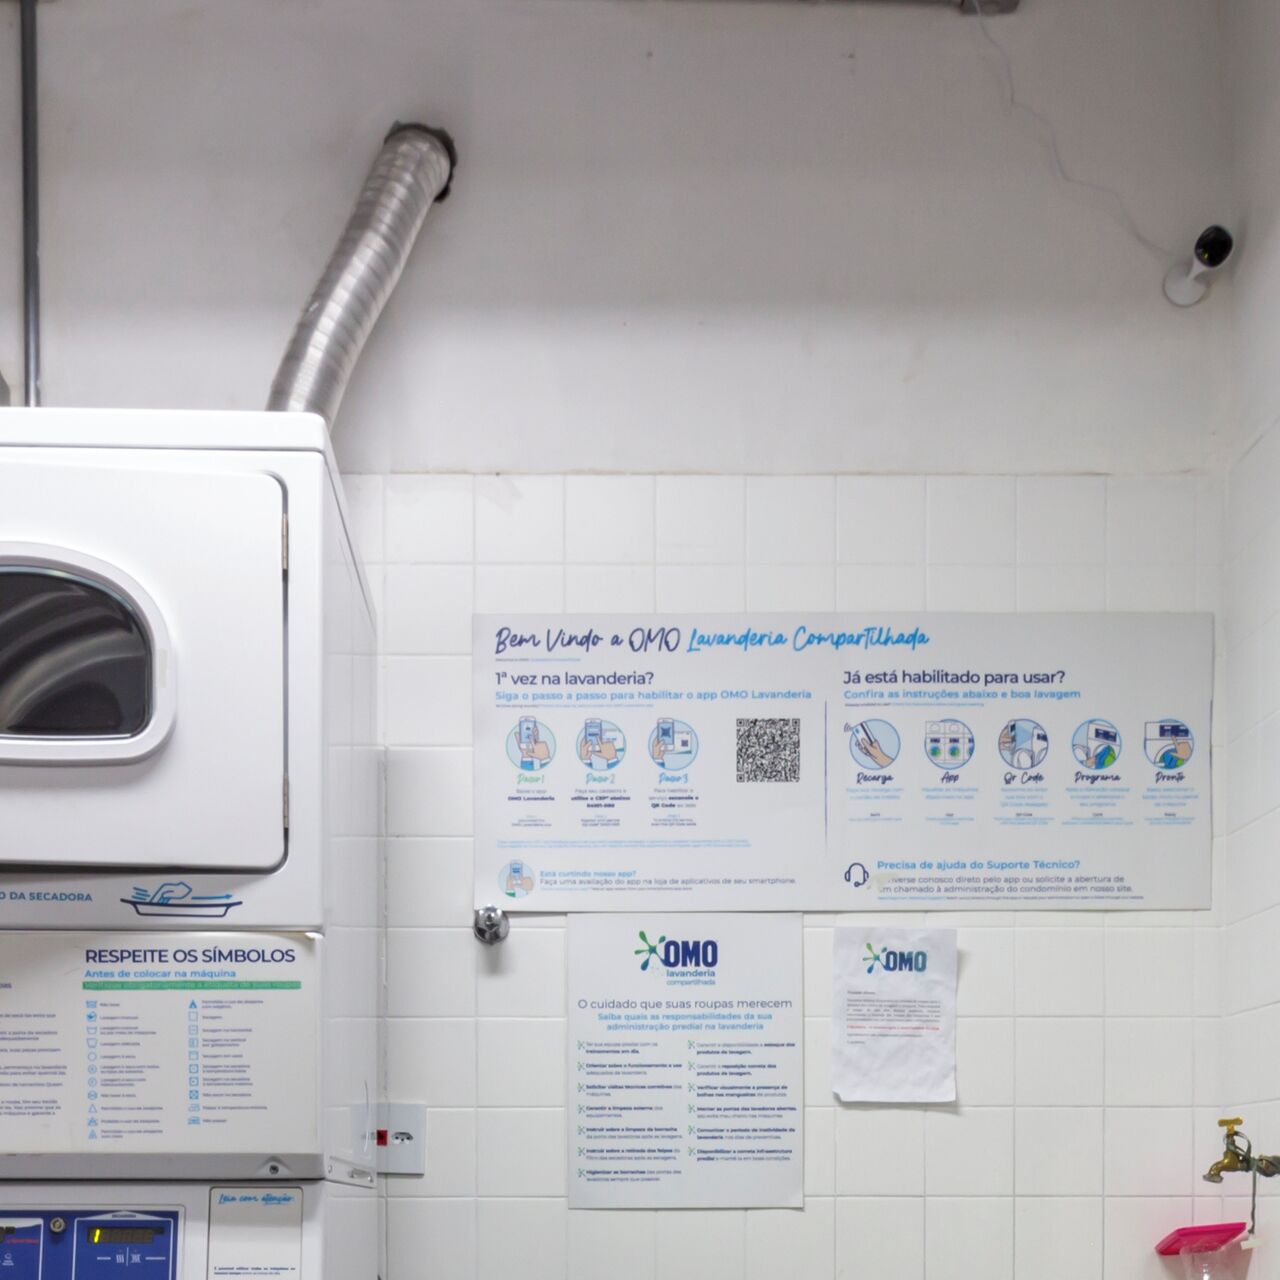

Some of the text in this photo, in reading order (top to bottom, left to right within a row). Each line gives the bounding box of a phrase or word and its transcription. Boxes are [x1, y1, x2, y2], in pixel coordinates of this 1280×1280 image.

[495, 625, 930, 654] Bem Vindo a OMO Lavanderia Compartilhada
[496, 671, 653, 686] 1ª vez na lavanderia?
[843, 669, 1064, 688] Já está habilitado para usar?
[496, 690, 812, 703] Siga o passo a passo para habilitar o app OMO Lavanderia
[844, 689, 1080, 701] Confira as instruções abaixo e boa lavagem
[856, 771, 894, 786] Recarga
[940, 771, 960, 785] App
[1020, 771, 1044, 784] Code
[1074, 771, 1121, 786] Programa
[1154, 771, 1186, 784] Pronto
[877, 860, 1079, 872] Precisa de ajuda do Suporte Técnico?
[10, 891, 26, 901] DA
[29, 891, 92, 902] SECADORA
[85, 946, 296, 963] RESPEITE OS SÍMBOLOS
[664, 939, 718, 968] OMO
[884, 951, 928, 973] OMO
[85, 970, 115, 978] Antes
[118, 970, 130, 978] de
[134, 970, 171, 978] colocar
[190, 970, 236, 980] máquina
[666, 969, 716, 978] lavanderia
[578, 998, 791, 1012] O cuidado que suas roupas merecem
